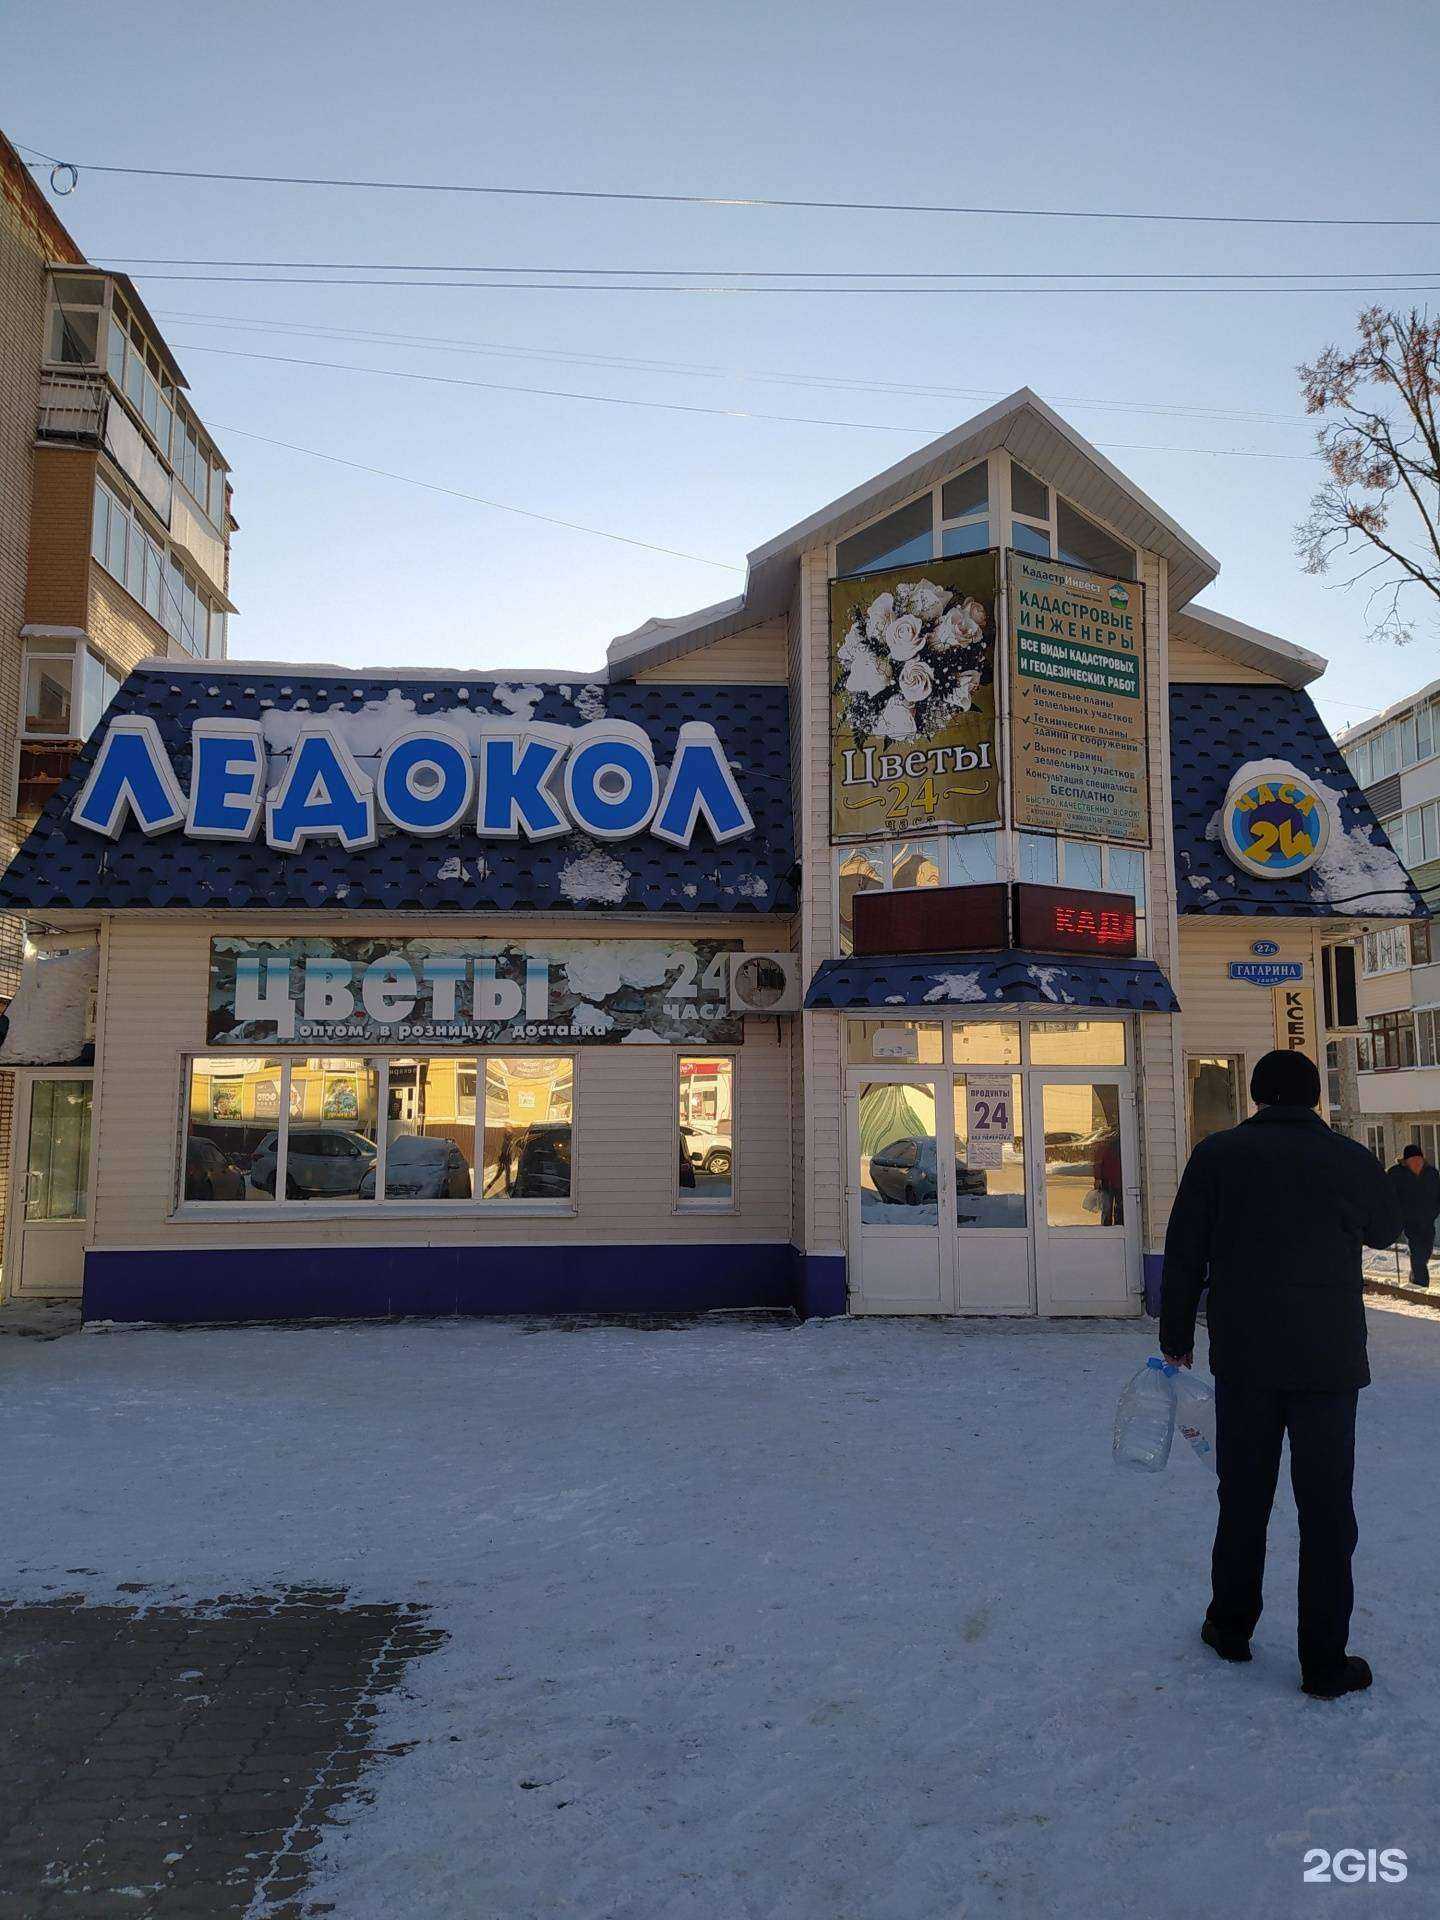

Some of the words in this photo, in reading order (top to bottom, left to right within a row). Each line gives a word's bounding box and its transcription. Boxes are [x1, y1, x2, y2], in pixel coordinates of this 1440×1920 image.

[1019, 589, 1134, 631] КАДАСТРОВЫЕ
[1020, 610, 1135, 651] ИНЖЕНЕРЫ
[1020, 638, 1039, 653] ВСЕ
[1040, 642, 1068, 660] ВИДЫ
[1069, 649, 1135, 674] КАДАСТРОВЫХ
[1020, 657, 1028, 670] И
[1029, 659, 1107, 687] ГЕОДЕЗИЧЕСКИХ
[1107, 676, 1136, 692] РАБОТ
[1033, 684, 1082, 702] Межевые
[1083, 696, 1114, 709] планы
[1033, 698, 1089, 716] земельных
[1091, 709, 1134, 725] участков
[1033, 712, 1096, 733] Технические
[1098, 727, 1128, 740] планы
[842, 742, 992, 788] Цветы
[1034, 742, 1067, 756] Вынос
[1069, 750, 1103, 764] границ
[1025, 767, 1084, 786] Консультация
[1033, 756, 1090, 773] земельных
[1092, 765, 1136, 780] участков
[70, 718, 757, 855] ЛЕДОКОЛ
[885, 777, 940, 820] 24
[1050, 784, 1115, 804] БЕСПЛАТНО
[1234, 783, 1316, 818] ЧАСА
[1243, 819, 1314, 863] 24
[664, 951, 730, 998] 24
[1236, 965, 1297, 976] ГАГАРИНА
[300, 1024, 372, 1039] оптом,
[380, 1024, 391, 1037] в
[399, 1024, 495, 1039] розницу,
[511, 1024, 606, 1038] доставка
[970, 1089, 1010, 1098] ПРОДУКТЫ
[974, 1101, 1009, 1130] 24
